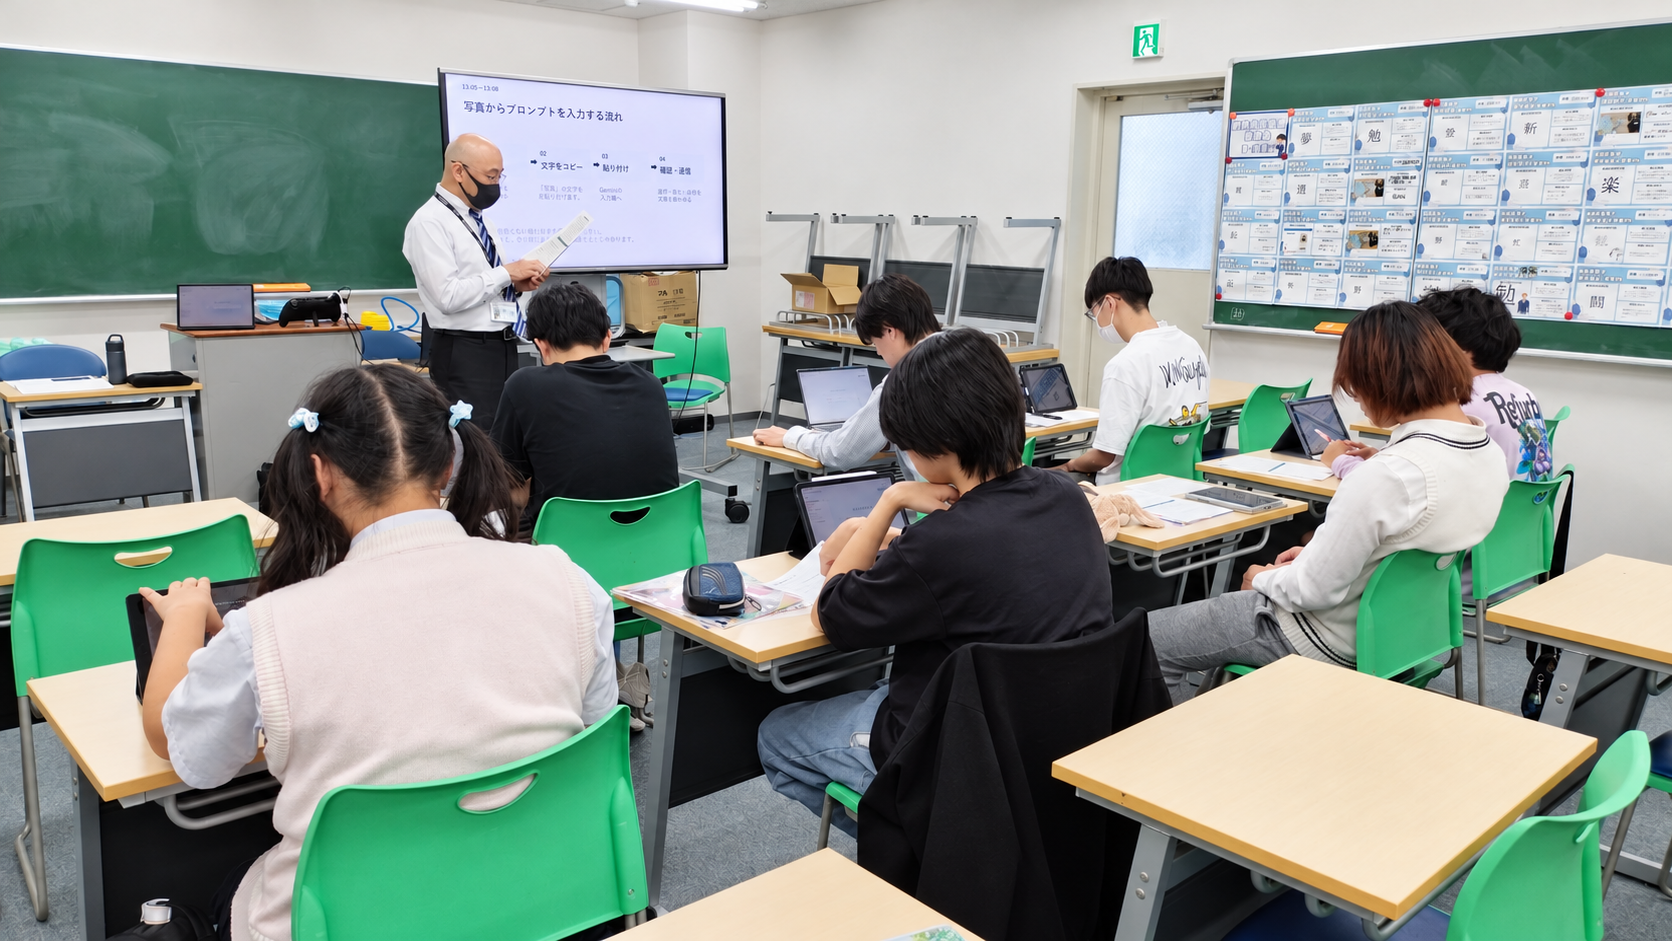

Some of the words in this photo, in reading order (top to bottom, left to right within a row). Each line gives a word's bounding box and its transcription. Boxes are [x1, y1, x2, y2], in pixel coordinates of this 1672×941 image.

[541, 162, 583, 171] 文字をコピー
[602, 164, 629, 173] 貼り付け
[1601, 176, 1620, 194] 楽
